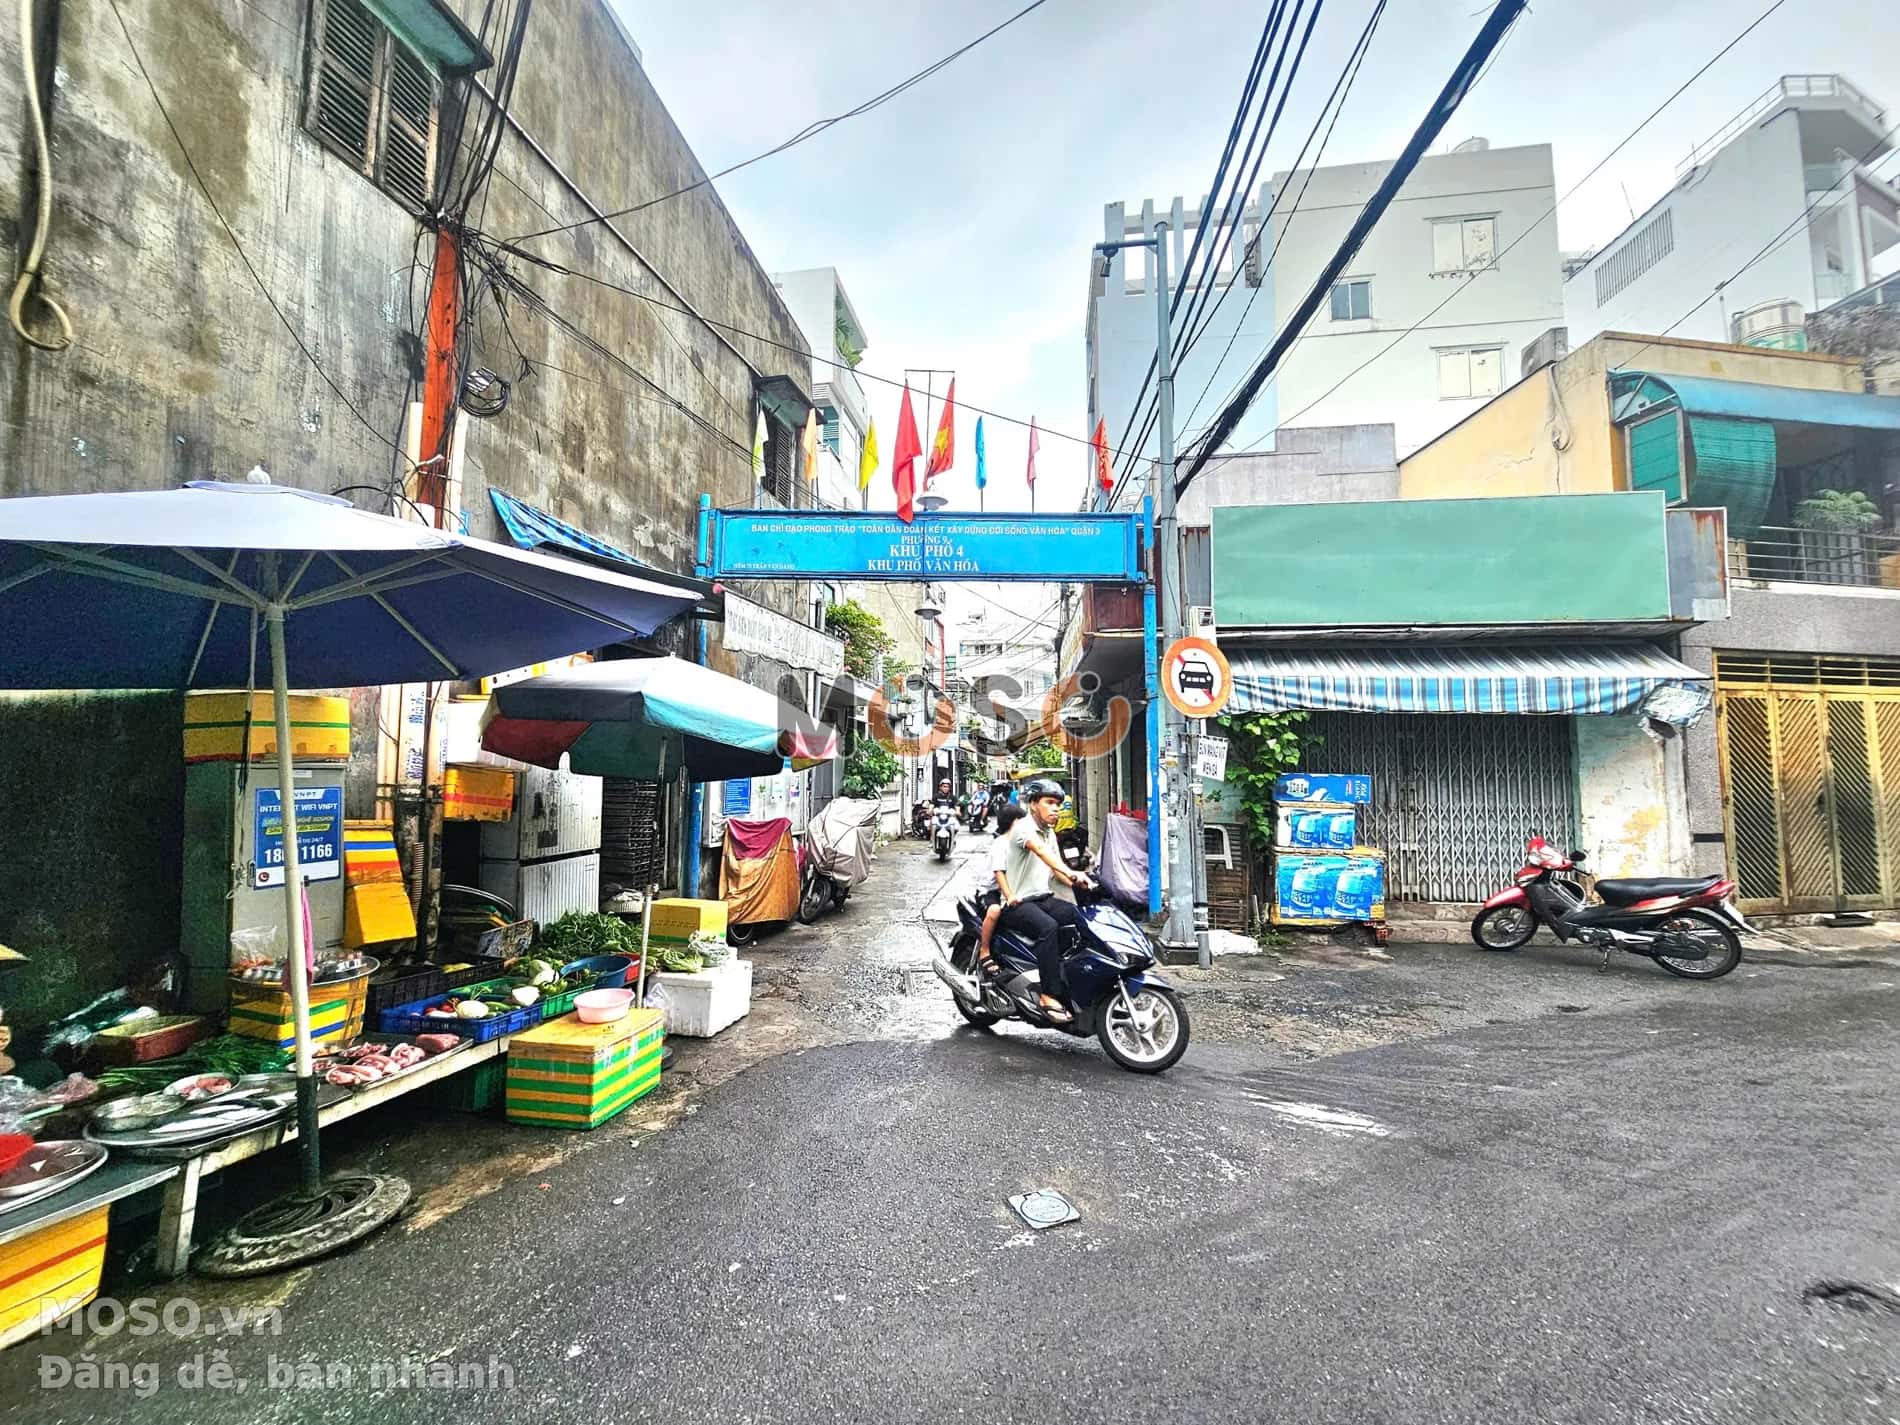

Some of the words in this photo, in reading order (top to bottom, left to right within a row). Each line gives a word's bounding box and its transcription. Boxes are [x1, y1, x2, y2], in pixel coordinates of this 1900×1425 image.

[751, 524, 769, 533] BAN
[804, 524, 832, 534] PHONG
[889, 544, 921, 557] KHU
[956, 544, 965, 557] 4
[867, 559, 895, 571] KHU
[925, 557, 951, 571] VĂN
[953, 557, 980, 572] HÓA
[301, 843, 333, 860] 1166
